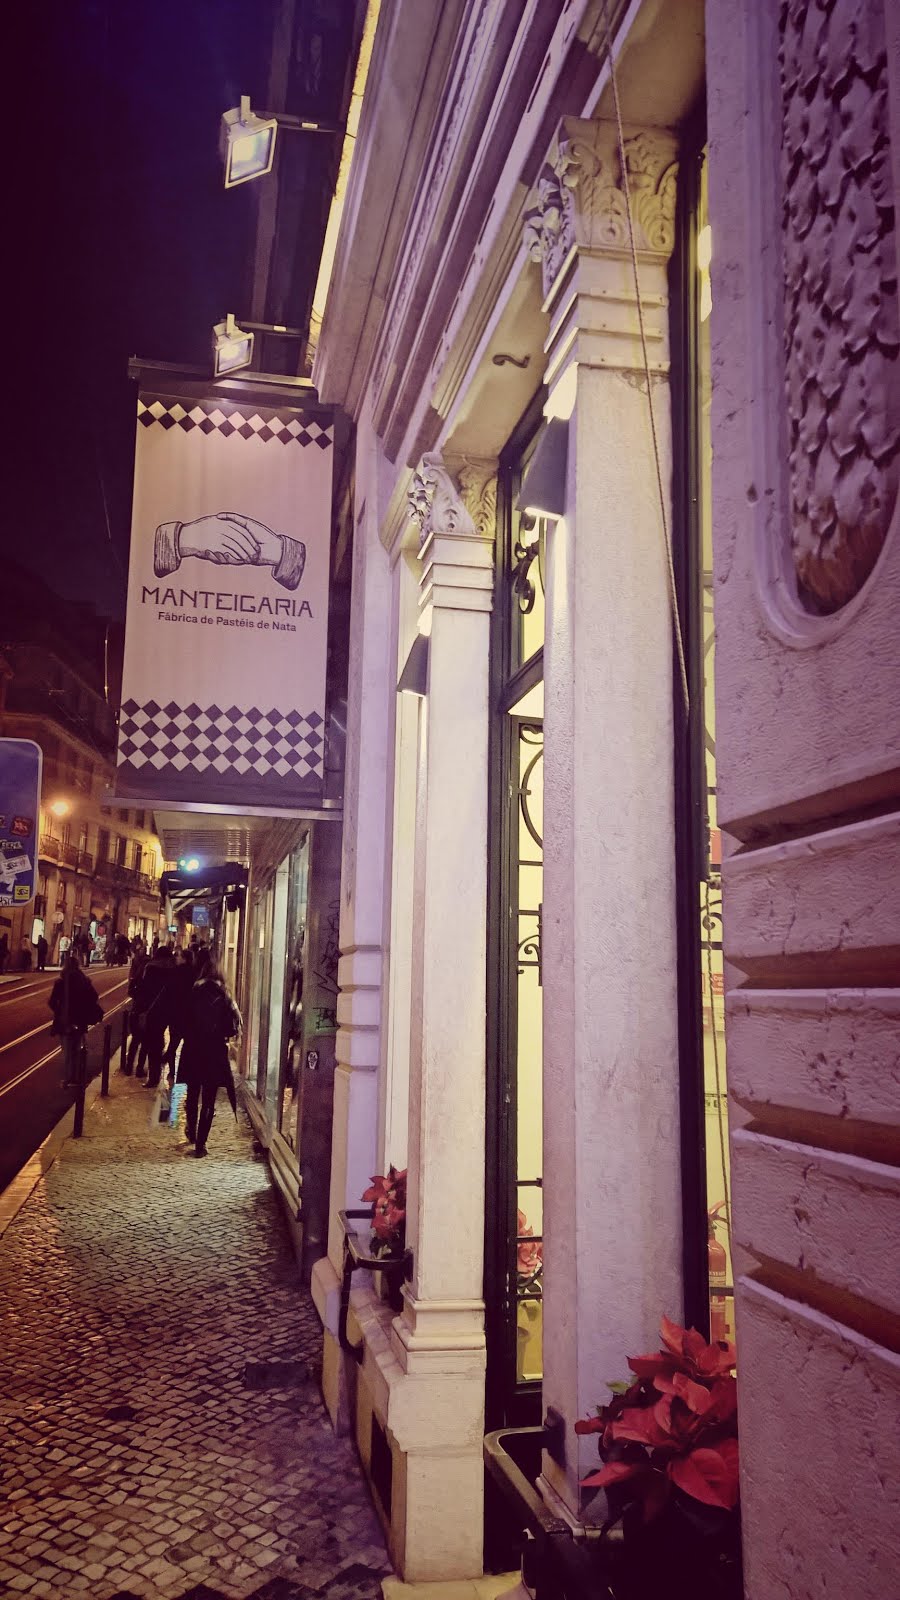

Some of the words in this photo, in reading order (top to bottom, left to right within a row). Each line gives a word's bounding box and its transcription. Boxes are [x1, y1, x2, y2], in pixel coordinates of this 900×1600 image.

[142, 586, 313, 618] MANTEIGARIA
[158, 611, 198, 624] Fábrica
[200, 615, 214, 625] de
[216, 616, 254, 629] Pastéis
[257, 619, 270, 629] de
[272, 622, 297, 632] Nata
